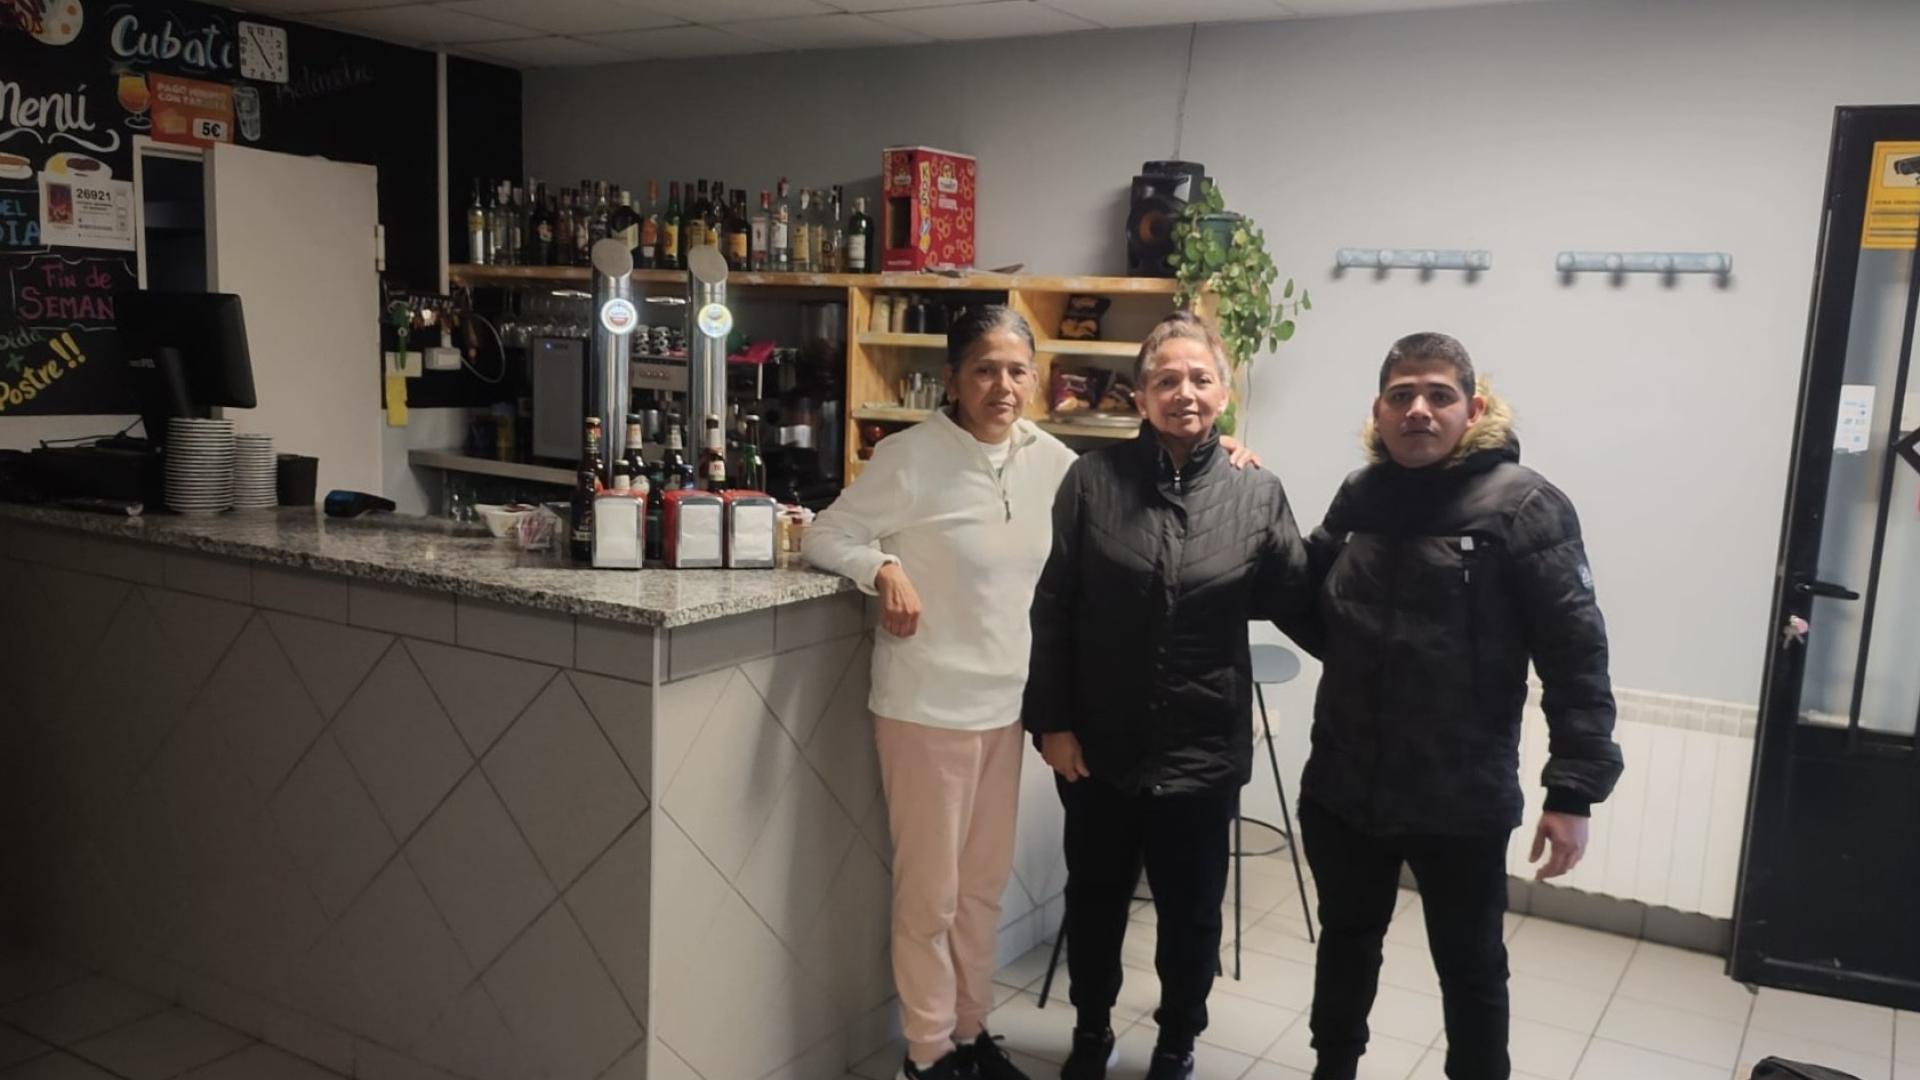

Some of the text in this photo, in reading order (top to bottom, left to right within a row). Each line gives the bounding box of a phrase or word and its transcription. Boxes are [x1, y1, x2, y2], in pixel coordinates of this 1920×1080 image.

[0, 80, 96, 132] Menú
[202, 122, 221, 137] 5€
[76, 188, 111, 201] 26921
[0, 199, 28, 216] EL
[86, 265, 112, 289] de
